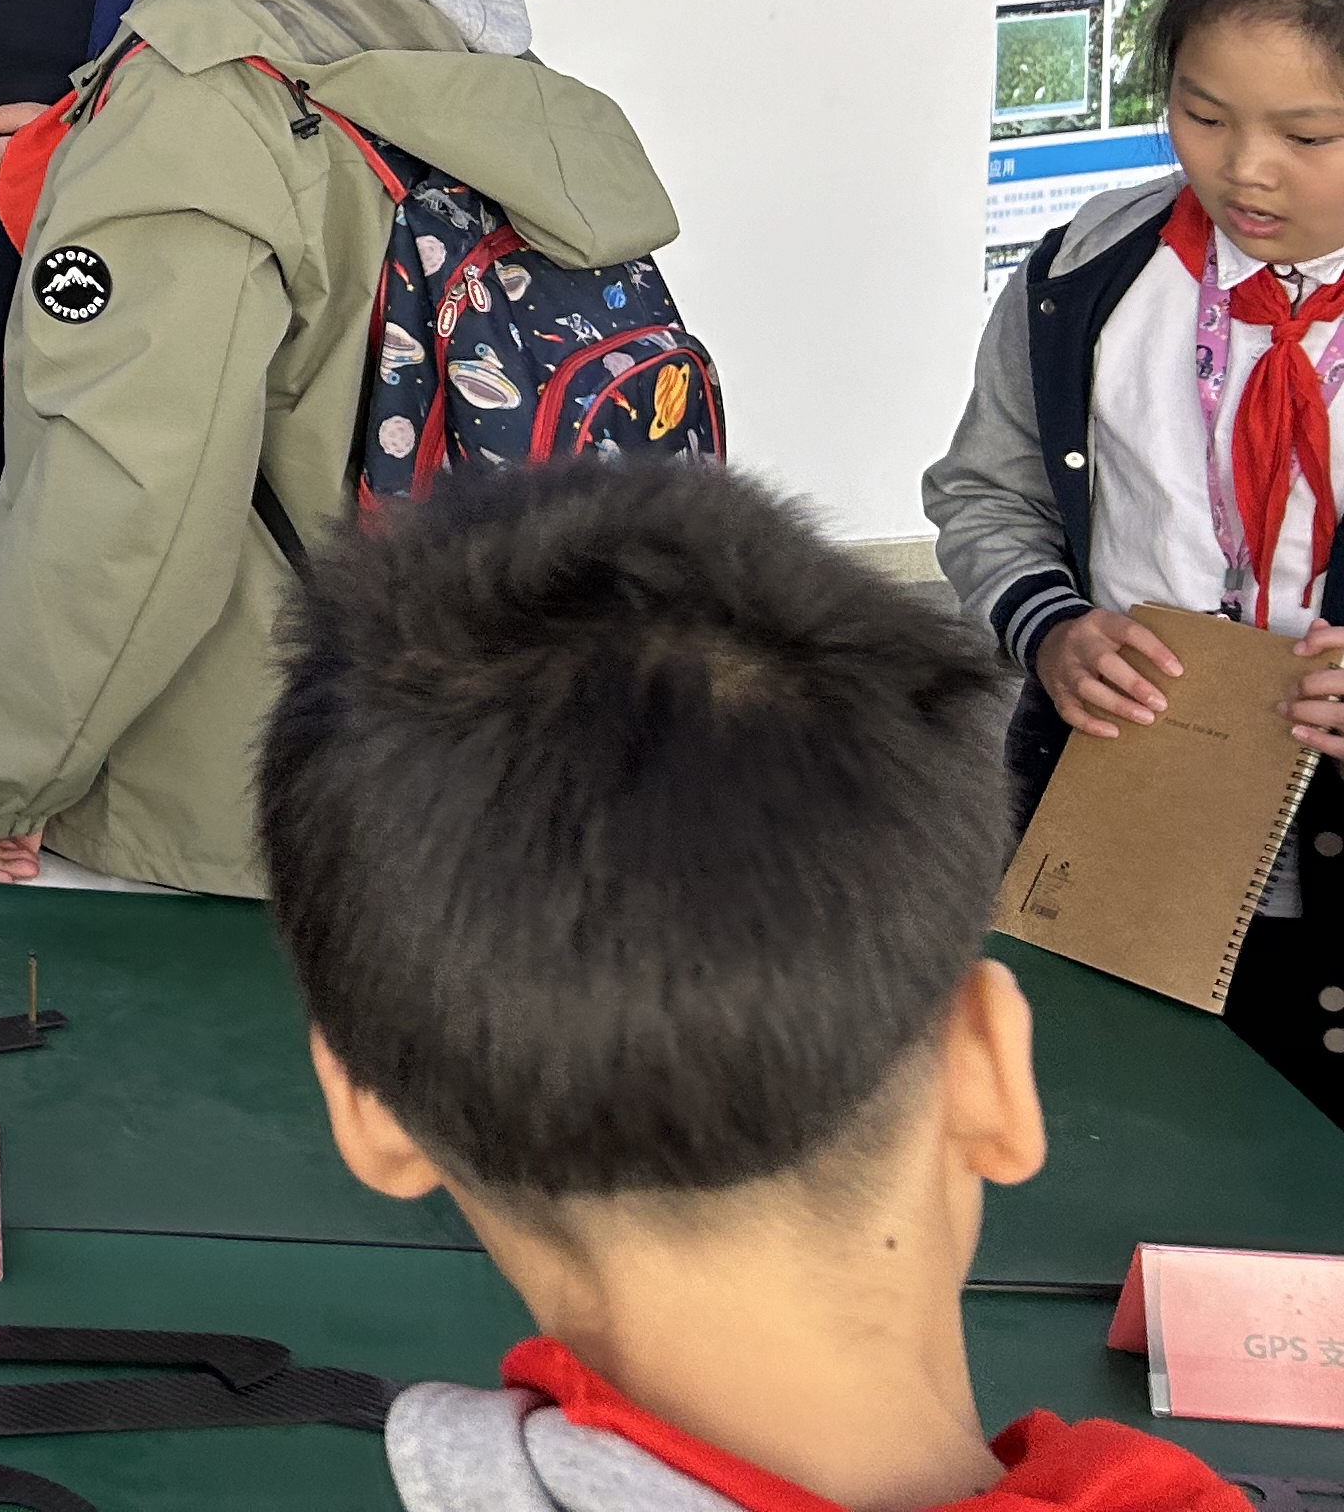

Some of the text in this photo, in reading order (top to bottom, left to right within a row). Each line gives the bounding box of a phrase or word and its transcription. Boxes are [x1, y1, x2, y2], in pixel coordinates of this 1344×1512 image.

[46, 250, 97, 269] SPORT
[44, 296, 105, 320] OUTDOOR
[1243, 1333, 1344, 1368] GPS 支
